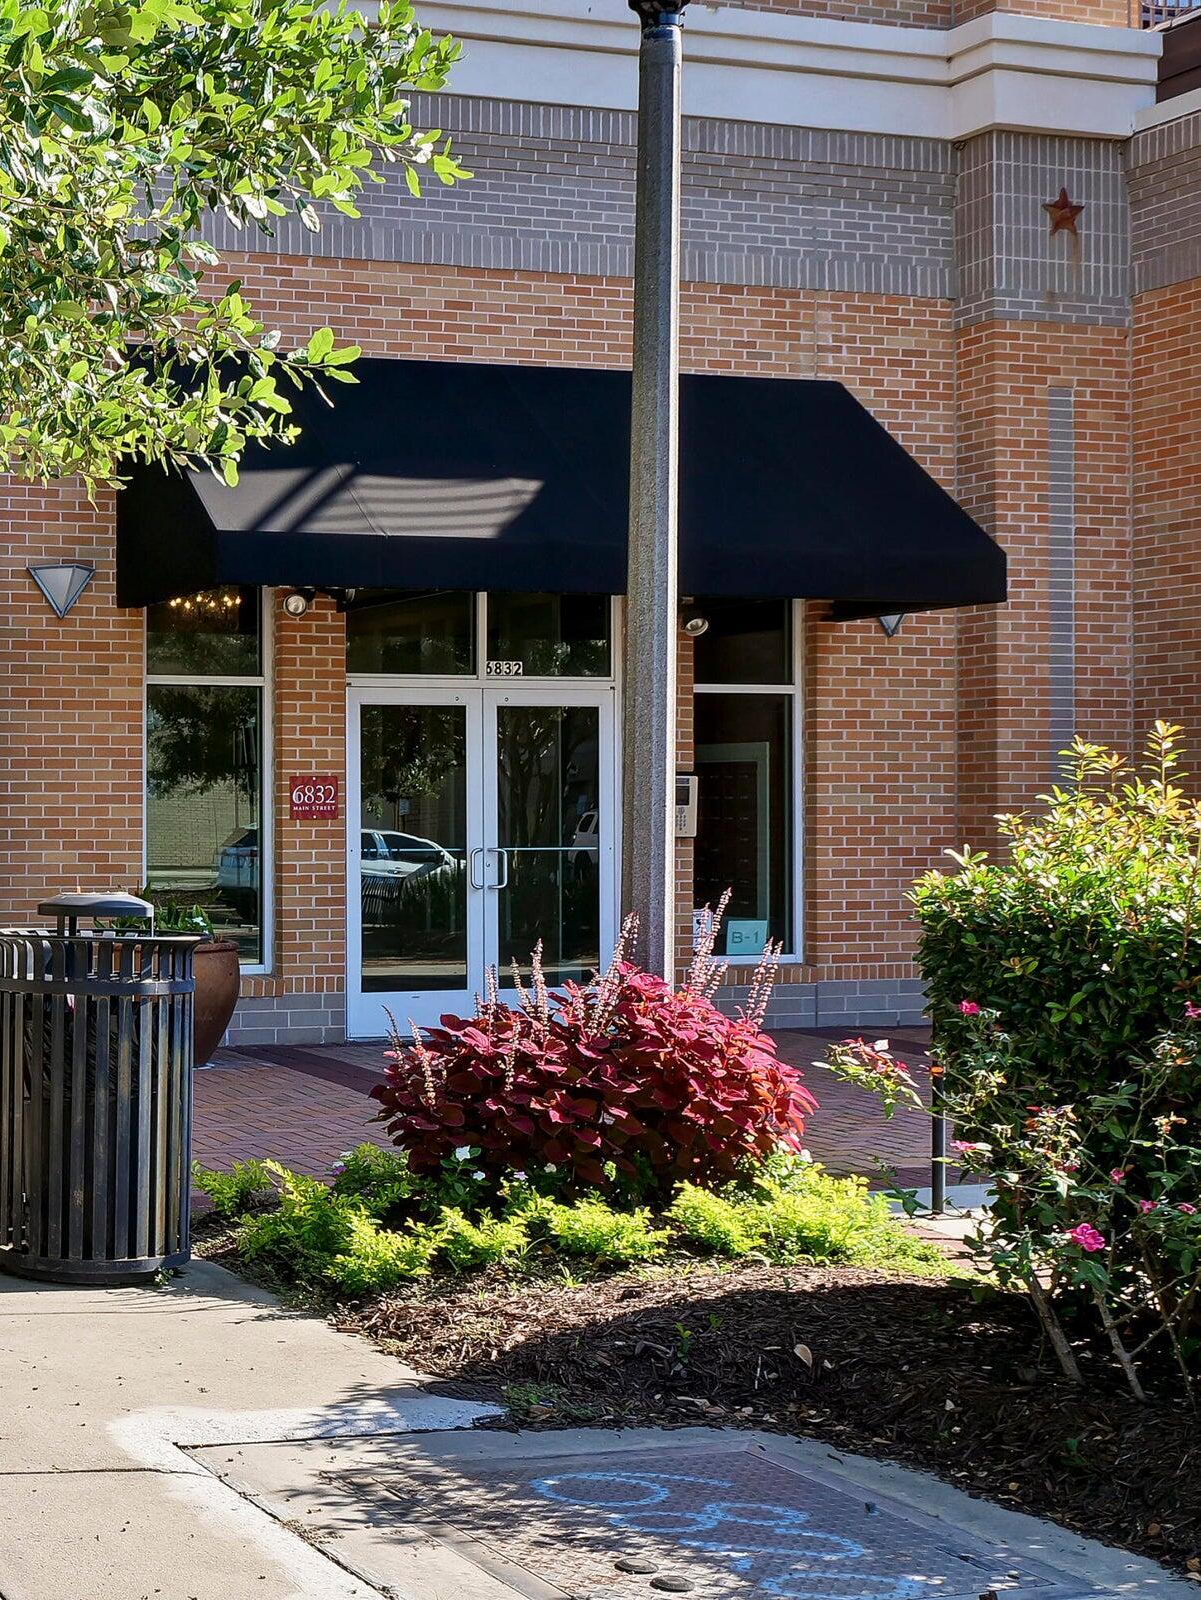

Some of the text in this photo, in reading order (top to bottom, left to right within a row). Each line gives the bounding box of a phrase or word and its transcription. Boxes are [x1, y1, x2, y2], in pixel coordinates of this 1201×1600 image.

[486, 661, 522, 675] 6832
[292, 785, 335, 804] 6832
[731, 931, 759, 944] B-1
